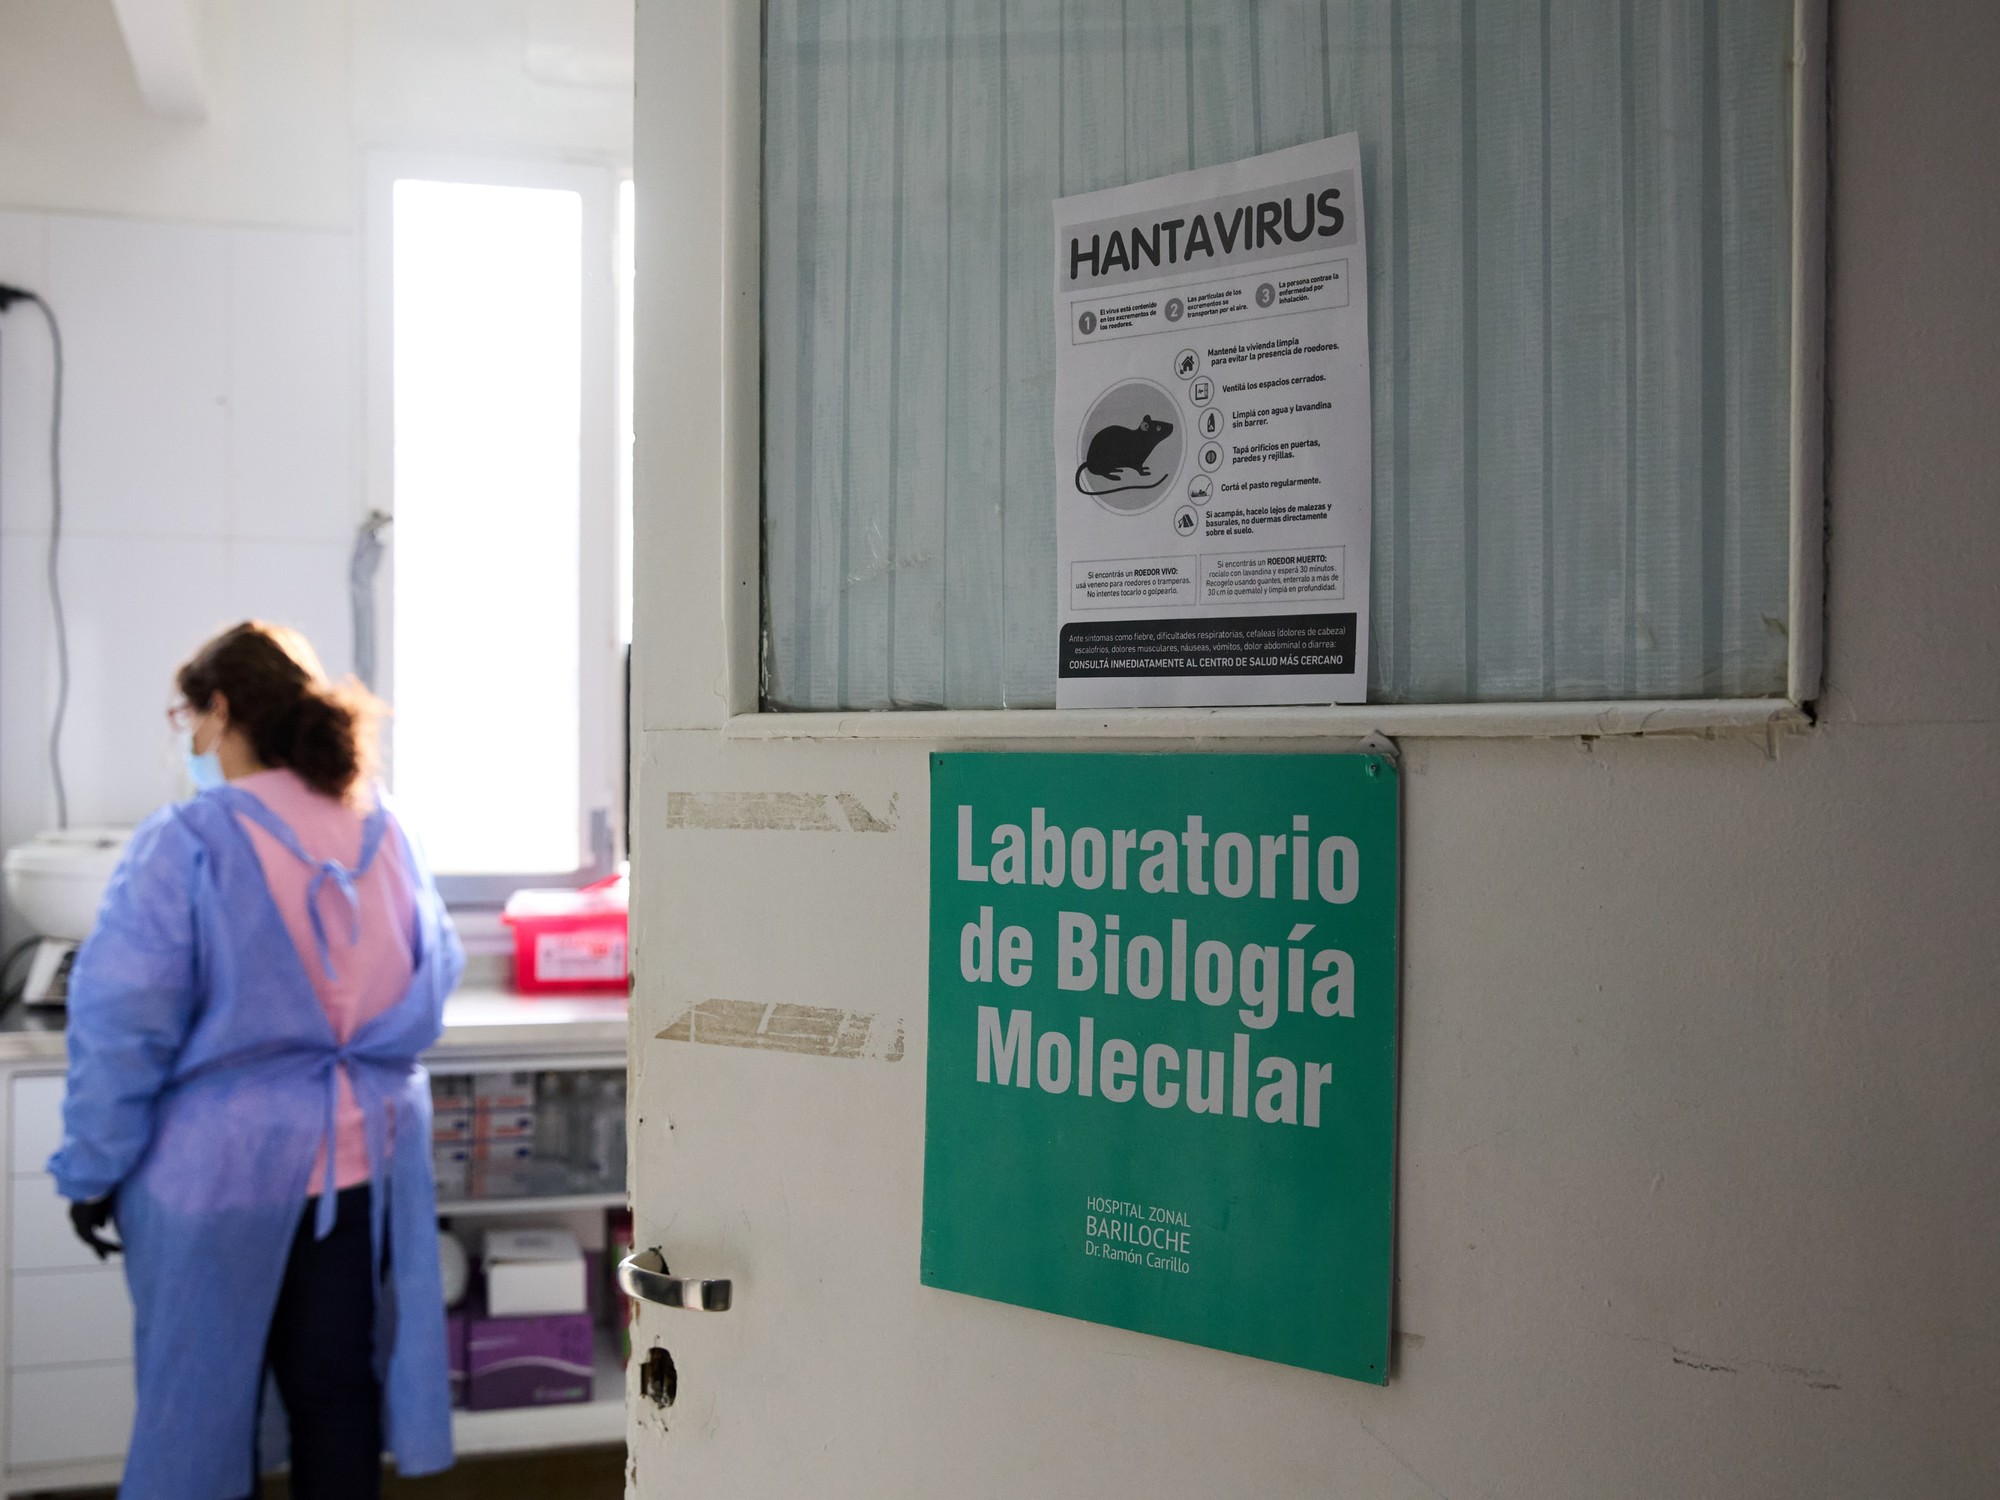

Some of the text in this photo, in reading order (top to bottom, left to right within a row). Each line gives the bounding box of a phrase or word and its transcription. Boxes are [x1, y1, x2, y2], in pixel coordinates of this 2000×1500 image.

[1070, 188, 1344, 280] HANTAVIRUS
[1286, 279, 1310, 287] persona
[1311, 274, 1332, 283] contrae
[1262, 289, 1270, 303] 3
[1279, 285, 1313, 296] enfermedad
[1132, 302, 1157, 311] contenido
[1171, 303, 1177, 318] 2
[1187, 299, 1222, 310] excrementos
[1116, 311, 1149, 320] excrementos
[1187, 306, 1219, 318] transportan
[1084, 317, 1090, 331] 1
[1238, 344, 1245, 352] la
[1246, 340, 1275, 351] vivienda
[1276, 338, 1299, 347] limpia
[1211, 357, 1227, 367] para
[1228, 352, 1248, 363] evitar
[1249, 352, 1256, 360] la
[1257, 348, 1291, 361] presencia
[1292, 346, 1302, 354] de
[1247, 381, 1258, 390] los
[1259, 378, 1290, 389] espacios
[1271, 406, 1289, 416] agua
[1290, 406, 1294, 414] y
[1295, 401, 1332, 412] lavandina
[1250, 444, 1279, 453] orificios
[1233, 455, 1261, 465] paredes
[1241, 482, 1248, 490] el
[1249, 480, 1269, 490] pasto
[1206, 511, 1213, 519] Si
[1246, 507, 1268, 516] hacelo
[1269, 506, 1286, 515] lejos
[1287, 505, 1296, 513] de
[1297, 503, 1326, 512] malezas
[1327, 503, 1332, 511] y
[1251, 515, 1282, 525] duermas
[1283, 512, 1327, 522] directamente
[1206, 528, 1225, 537] sobre
[1226, 527, 1233, 535] el
[1267, 556, 1295, 565] ROEDOR
[1088, 571, 1094, 579] Si
[1134, 569, 1160, 577] ROEDOR
[1242, 566, 1271, 576] lavandina
[1272, 568, 1277, 576] y
[1124, 578, 1151, 586] roedores
[1205, 578, 1233, 587] Recogelo
[1234, 577, 1256, 586] usando
[1283, 575, 1311, 583] enterralo
[1331, 573, 1338, 581] de
[1087, 590, 1096, 598] No
[1096, 588, 1119, 596] intentes
[1208, 588, 1215, 596] 30
[1264, 587, 1268, 595] y
[1157, 632, 1196, 640] dificultades
[1277, 628, 1305, 637] (dolores
[1111, 645, 1136, 653] dolores
[1244, 642, 1262, 650] dolor
[1264, 641, 1300, 649] abdominal
[1069, 654, 1343, 669] CONSULTÁ INMEDIATAMENTE AL CENTRO DE SALUD MÁS CERCANO
[957, 805, 1360, 905] Laboratorio
[960, 905, 1355, 1030] de Biología
[976, 1005, 1332, 1128] Molecular
[1087, 1196, 1191, 1228] HOSPITAL ZONAL
[1086, 1215, 1190, 1254] BARILOCHE
[1085, 1240, 1189, 1274] Dr. Ramón Carrillo
